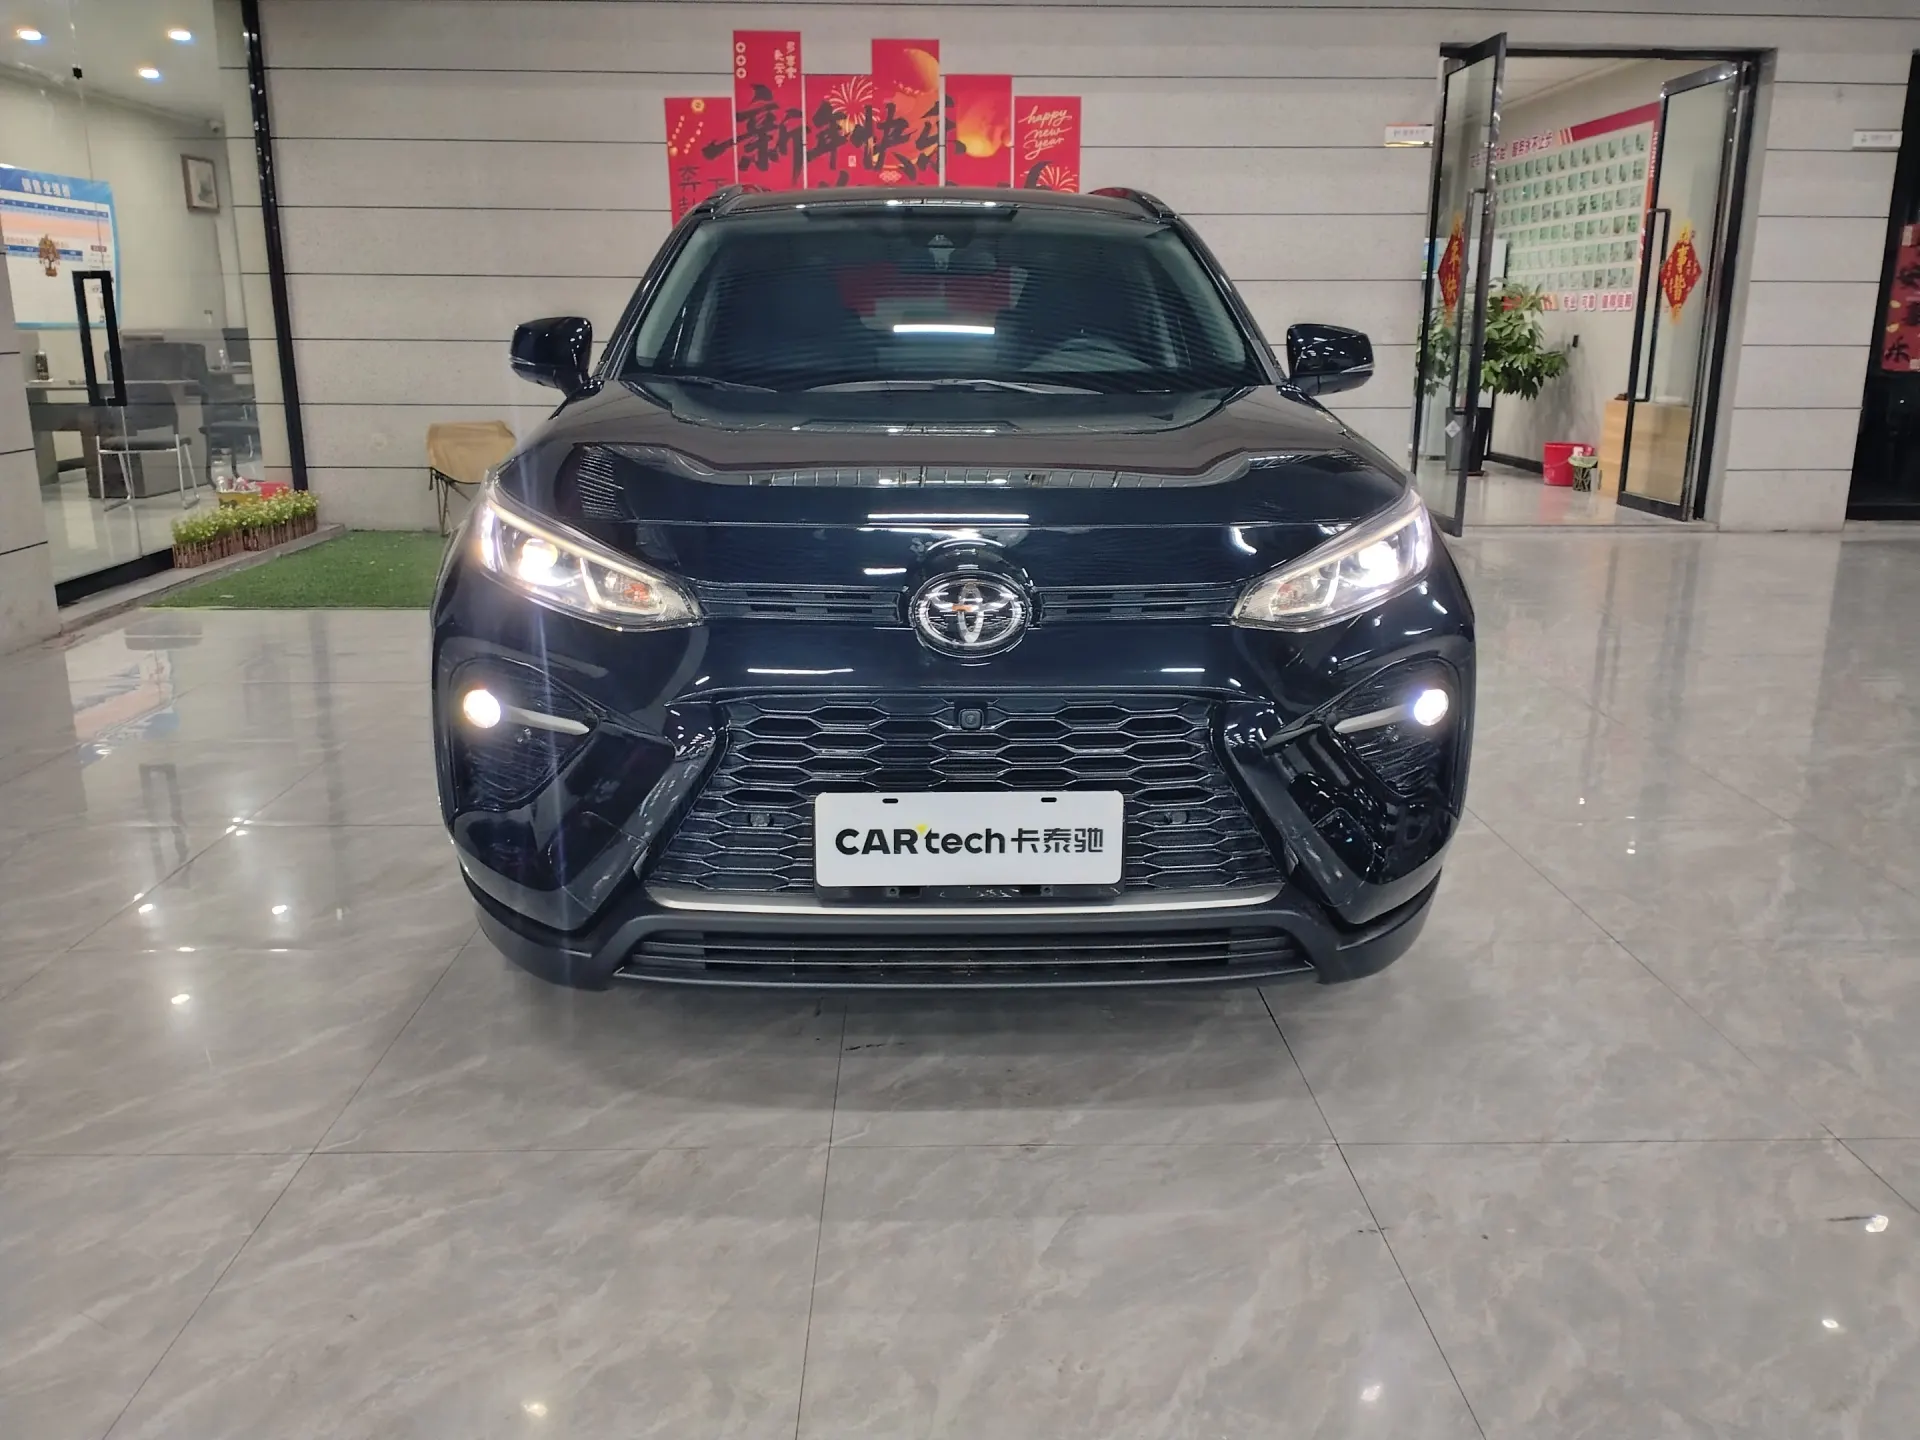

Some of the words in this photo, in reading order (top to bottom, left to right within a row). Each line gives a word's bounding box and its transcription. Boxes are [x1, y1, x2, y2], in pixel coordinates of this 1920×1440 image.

[1018, 105, 1073, 129] happy
[1023, 126, 1073, 141] new
[1023, 137, 1065, 161] year
[1011, 827, 1104, 854] 卡泰驰
